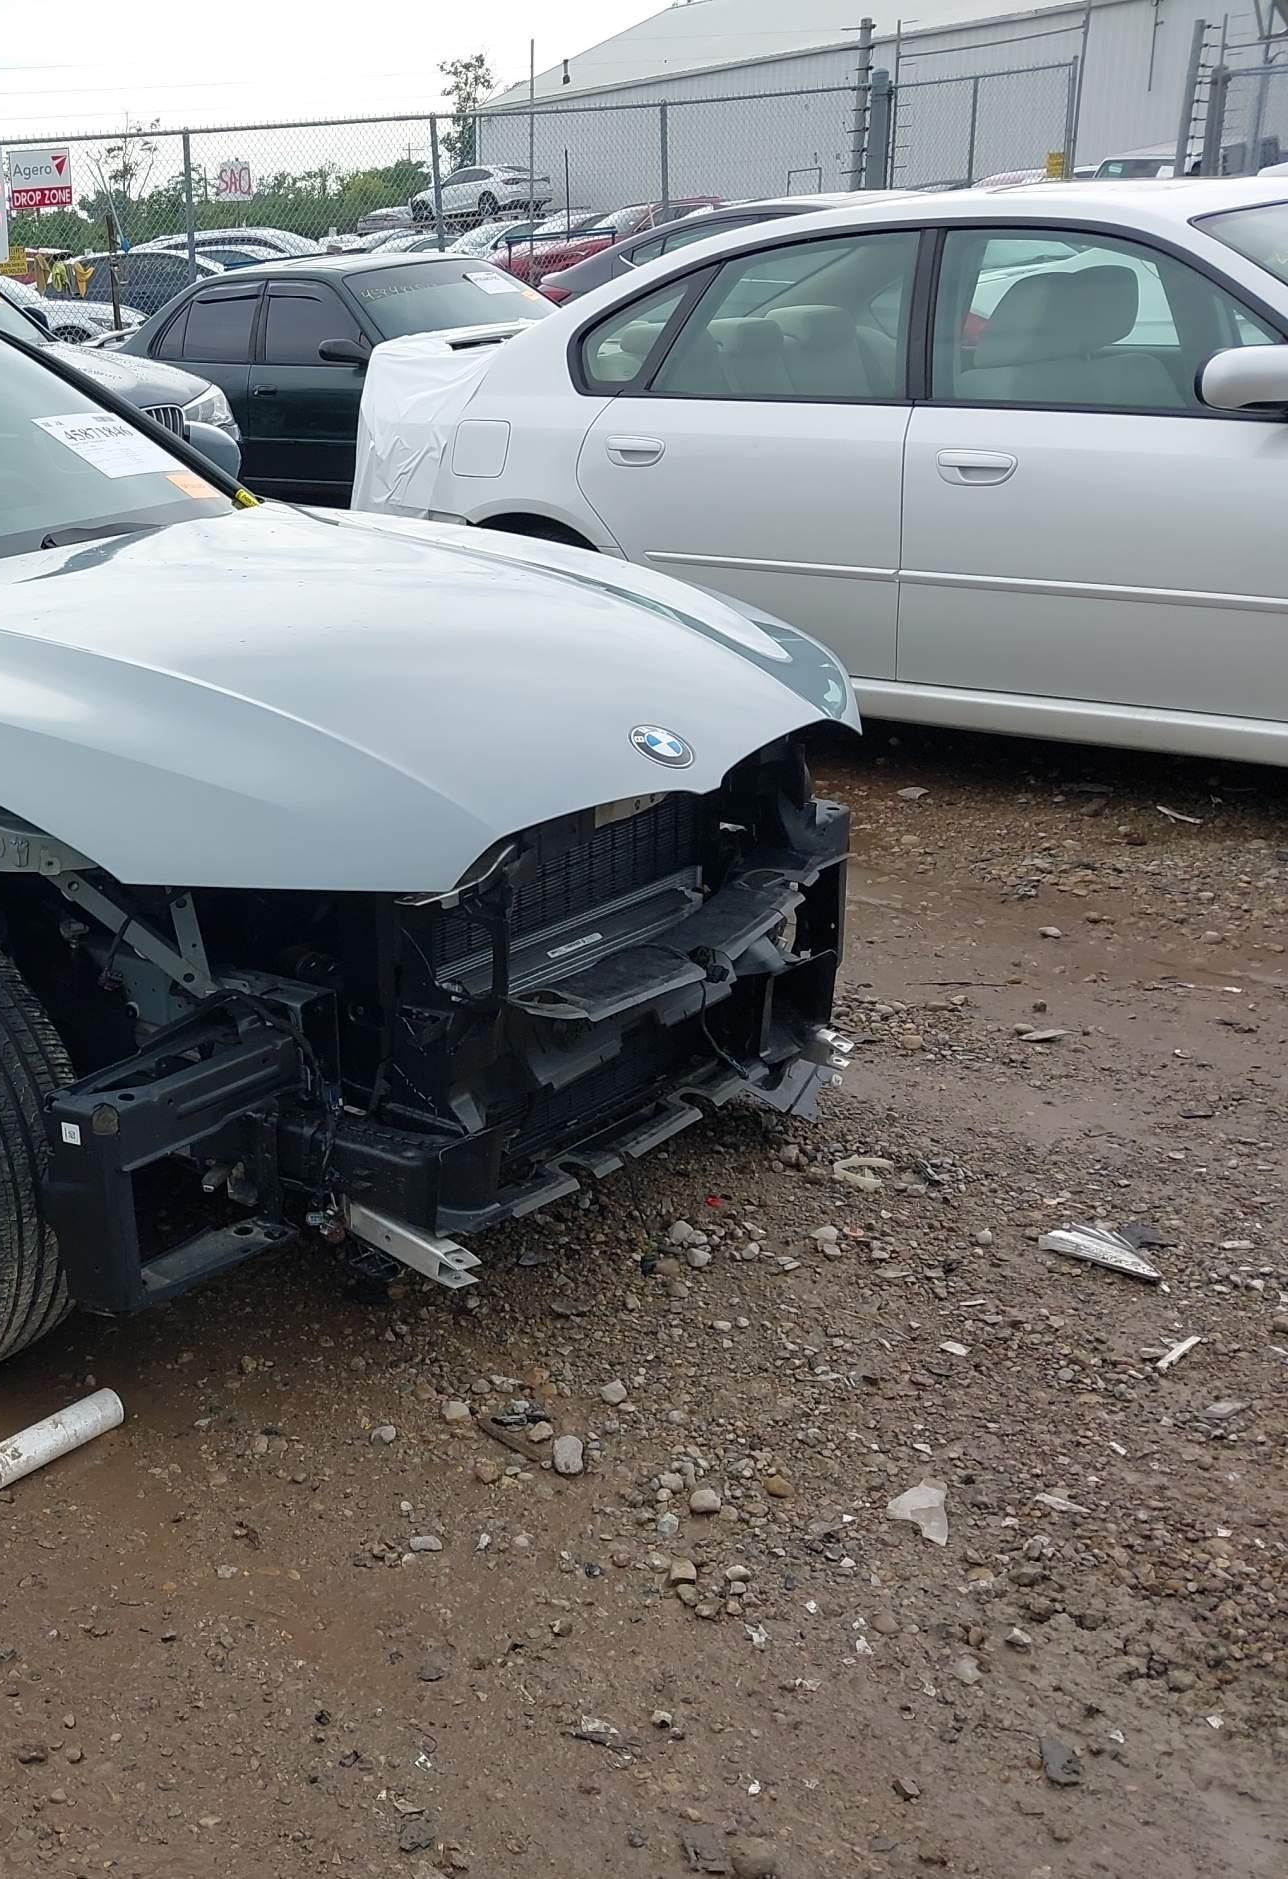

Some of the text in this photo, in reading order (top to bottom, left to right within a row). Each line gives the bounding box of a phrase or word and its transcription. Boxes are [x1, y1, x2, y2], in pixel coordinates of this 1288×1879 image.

[13, 164, 52, 180] Agero
[13, 188, 71, 206] DROP ZONE
[63, 425, 134, 442] 45871846
